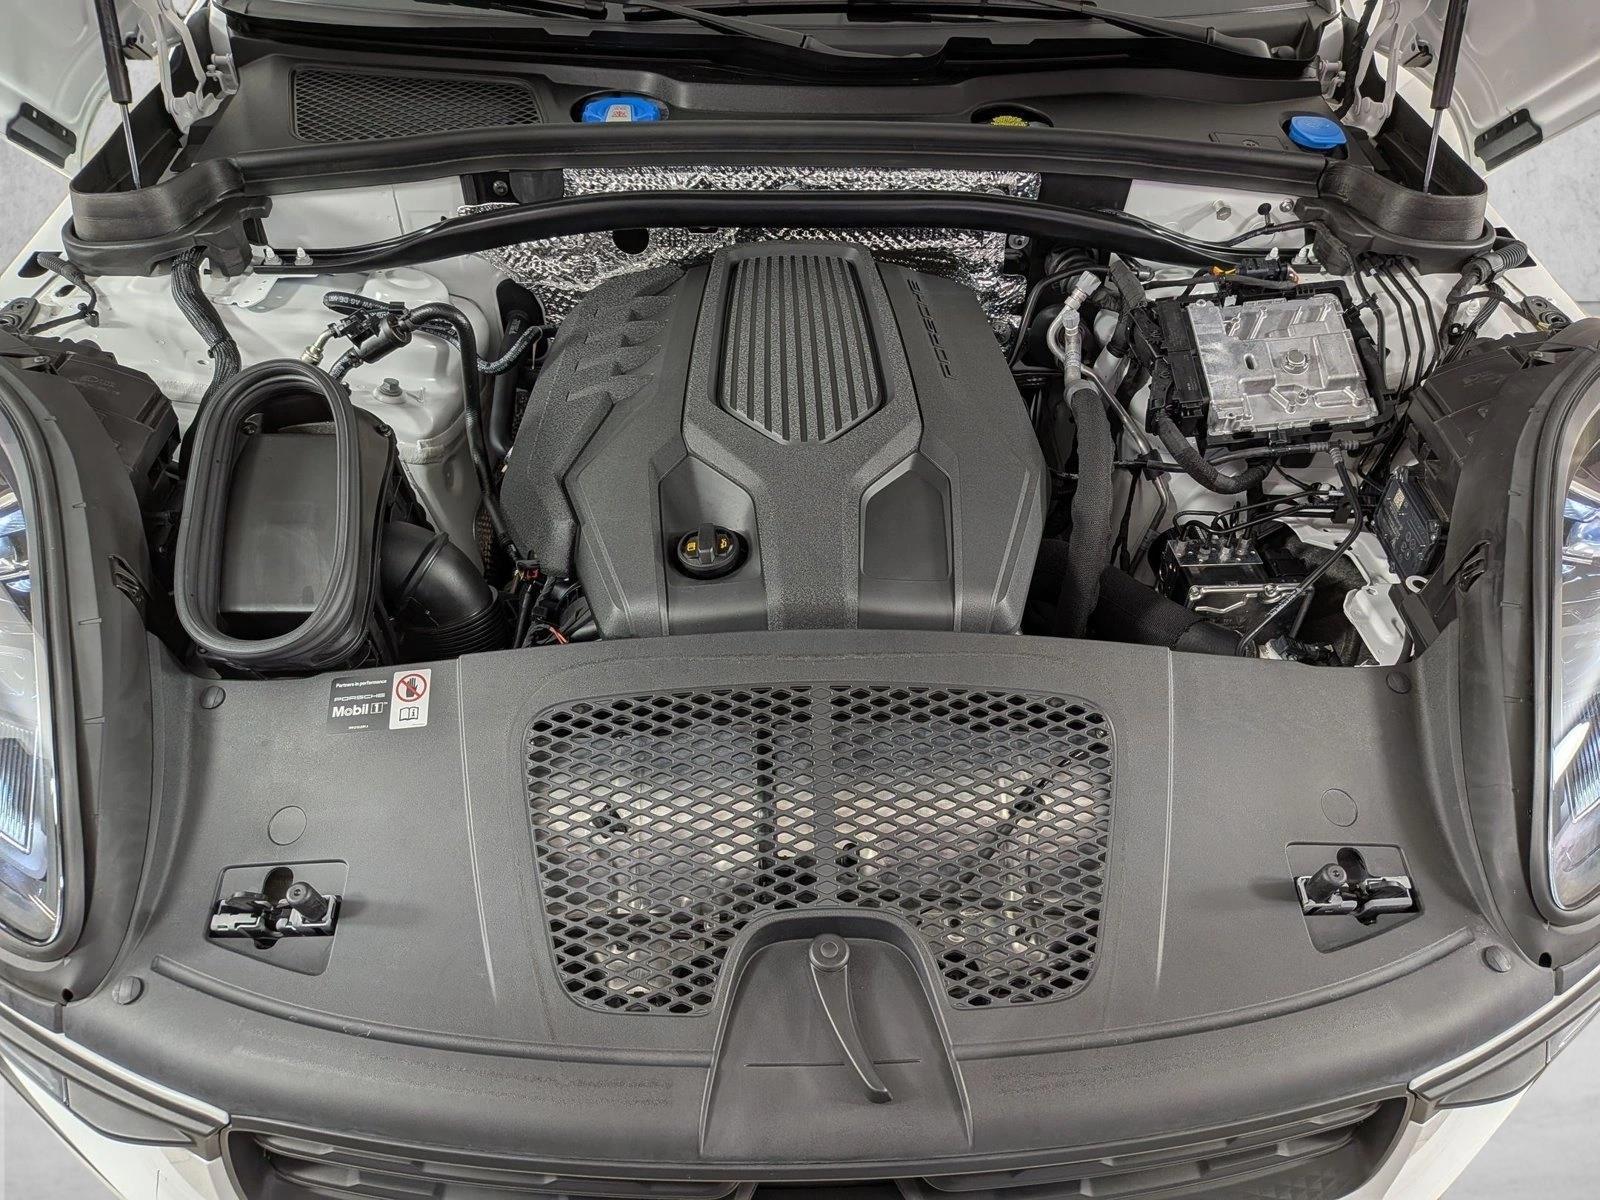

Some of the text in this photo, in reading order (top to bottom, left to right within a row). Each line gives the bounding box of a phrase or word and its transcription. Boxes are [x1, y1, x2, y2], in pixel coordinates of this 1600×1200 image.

[907, 279, 958, 380] PORSCHE
[360, 679, 387, 687] performance
[334, 693, 385, 702] PORSCHE
[332, 703, 369, 718] Mobil
